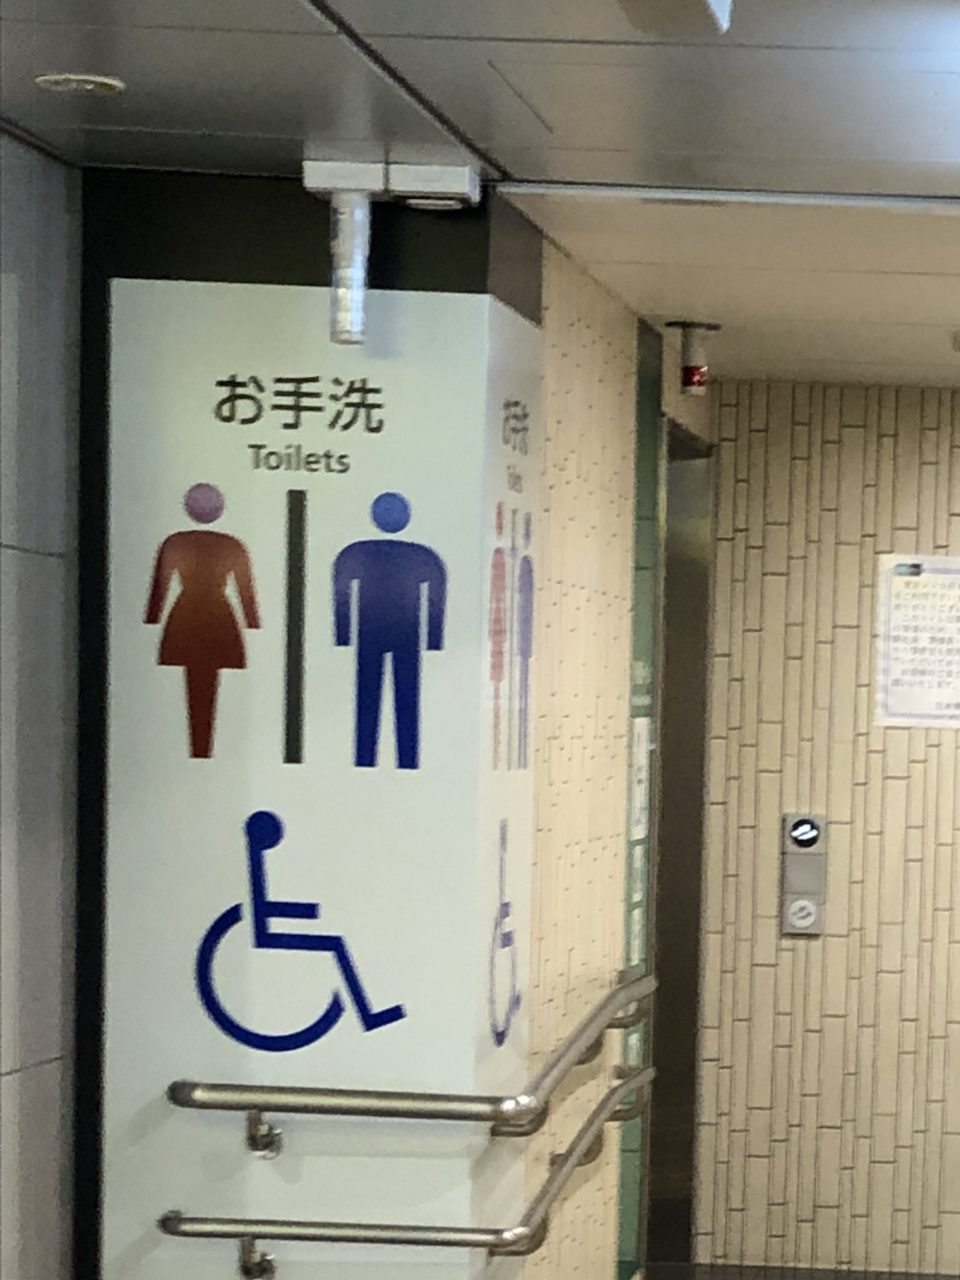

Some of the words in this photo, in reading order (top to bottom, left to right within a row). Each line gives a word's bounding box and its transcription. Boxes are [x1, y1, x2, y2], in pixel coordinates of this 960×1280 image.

[214, 373, 385, 434] お手洗
[247, 443, 352, 474] Toilets
